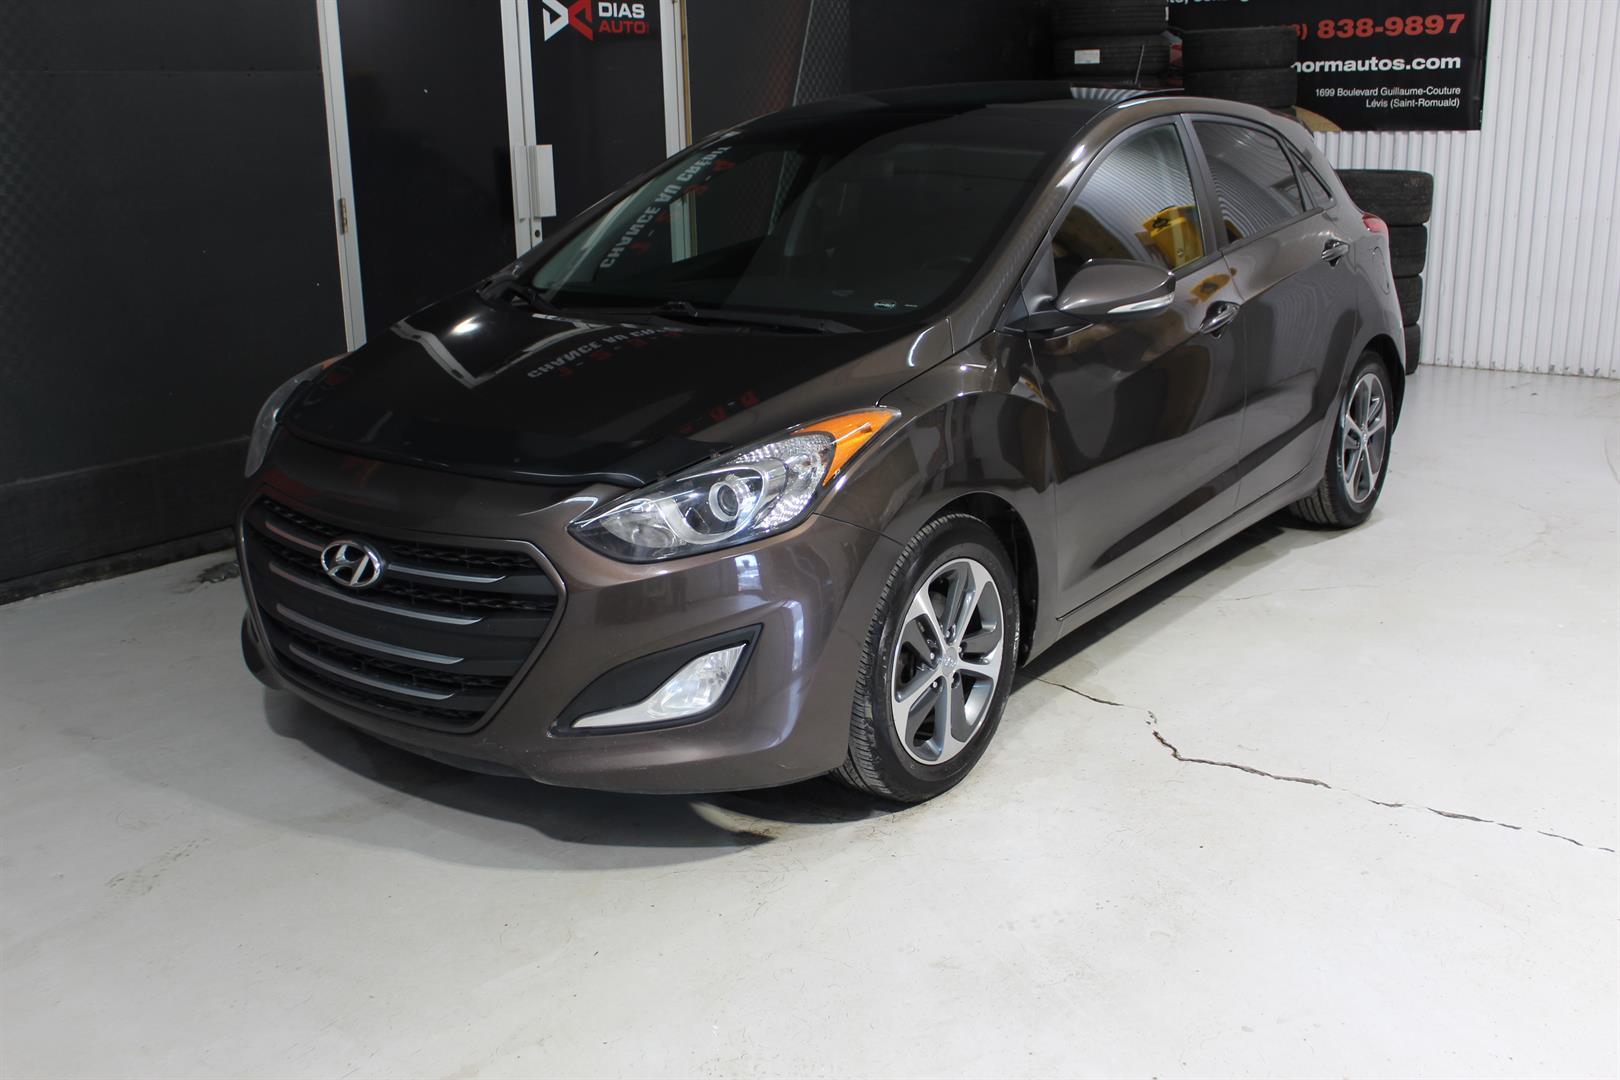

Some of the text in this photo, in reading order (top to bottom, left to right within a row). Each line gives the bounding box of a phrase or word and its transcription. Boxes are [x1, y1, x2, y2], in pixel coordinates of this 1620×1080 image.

[598, 2, 645, 18] DIAS
[1317, 13, 1465, 39] 838-9897
[1315, 86, 1461, 97] 1699 Boulevard Guillaume-Couture
[1366, 98, 1460, 109] Lévis (Saint-Romuald)
